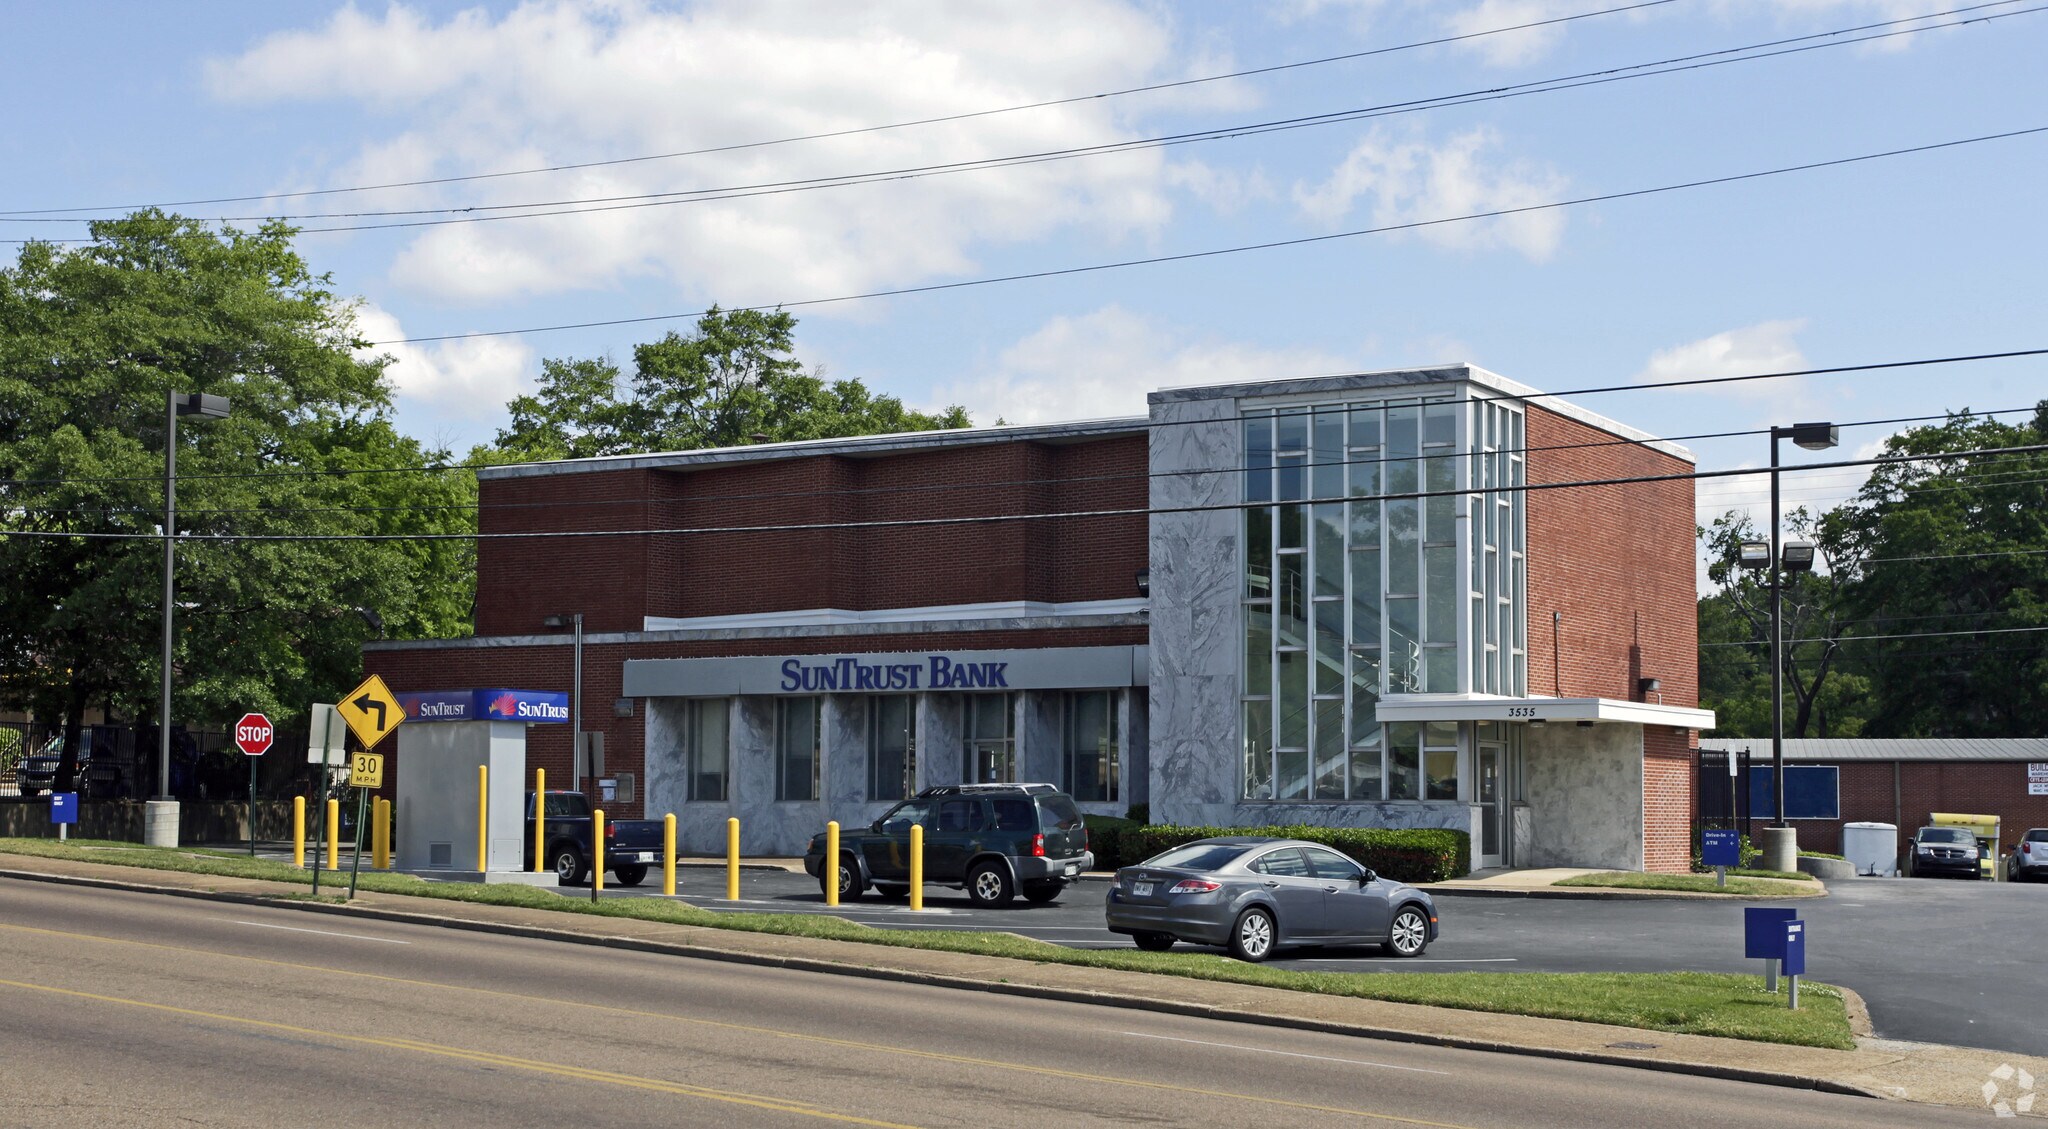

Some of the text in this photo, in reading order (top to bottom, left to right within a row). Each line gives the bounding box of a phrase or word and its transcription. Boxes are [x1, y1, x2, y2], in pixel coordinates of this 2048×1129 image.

[781, 656, 1008, 691] SUNTRUST BANK
[420, 702, 465, 717] SUNTRUST
[1508, 707, 1536, 717] 3535
[238, 726, 271, 743] STOP
[357, 757, 377, 774] 30
